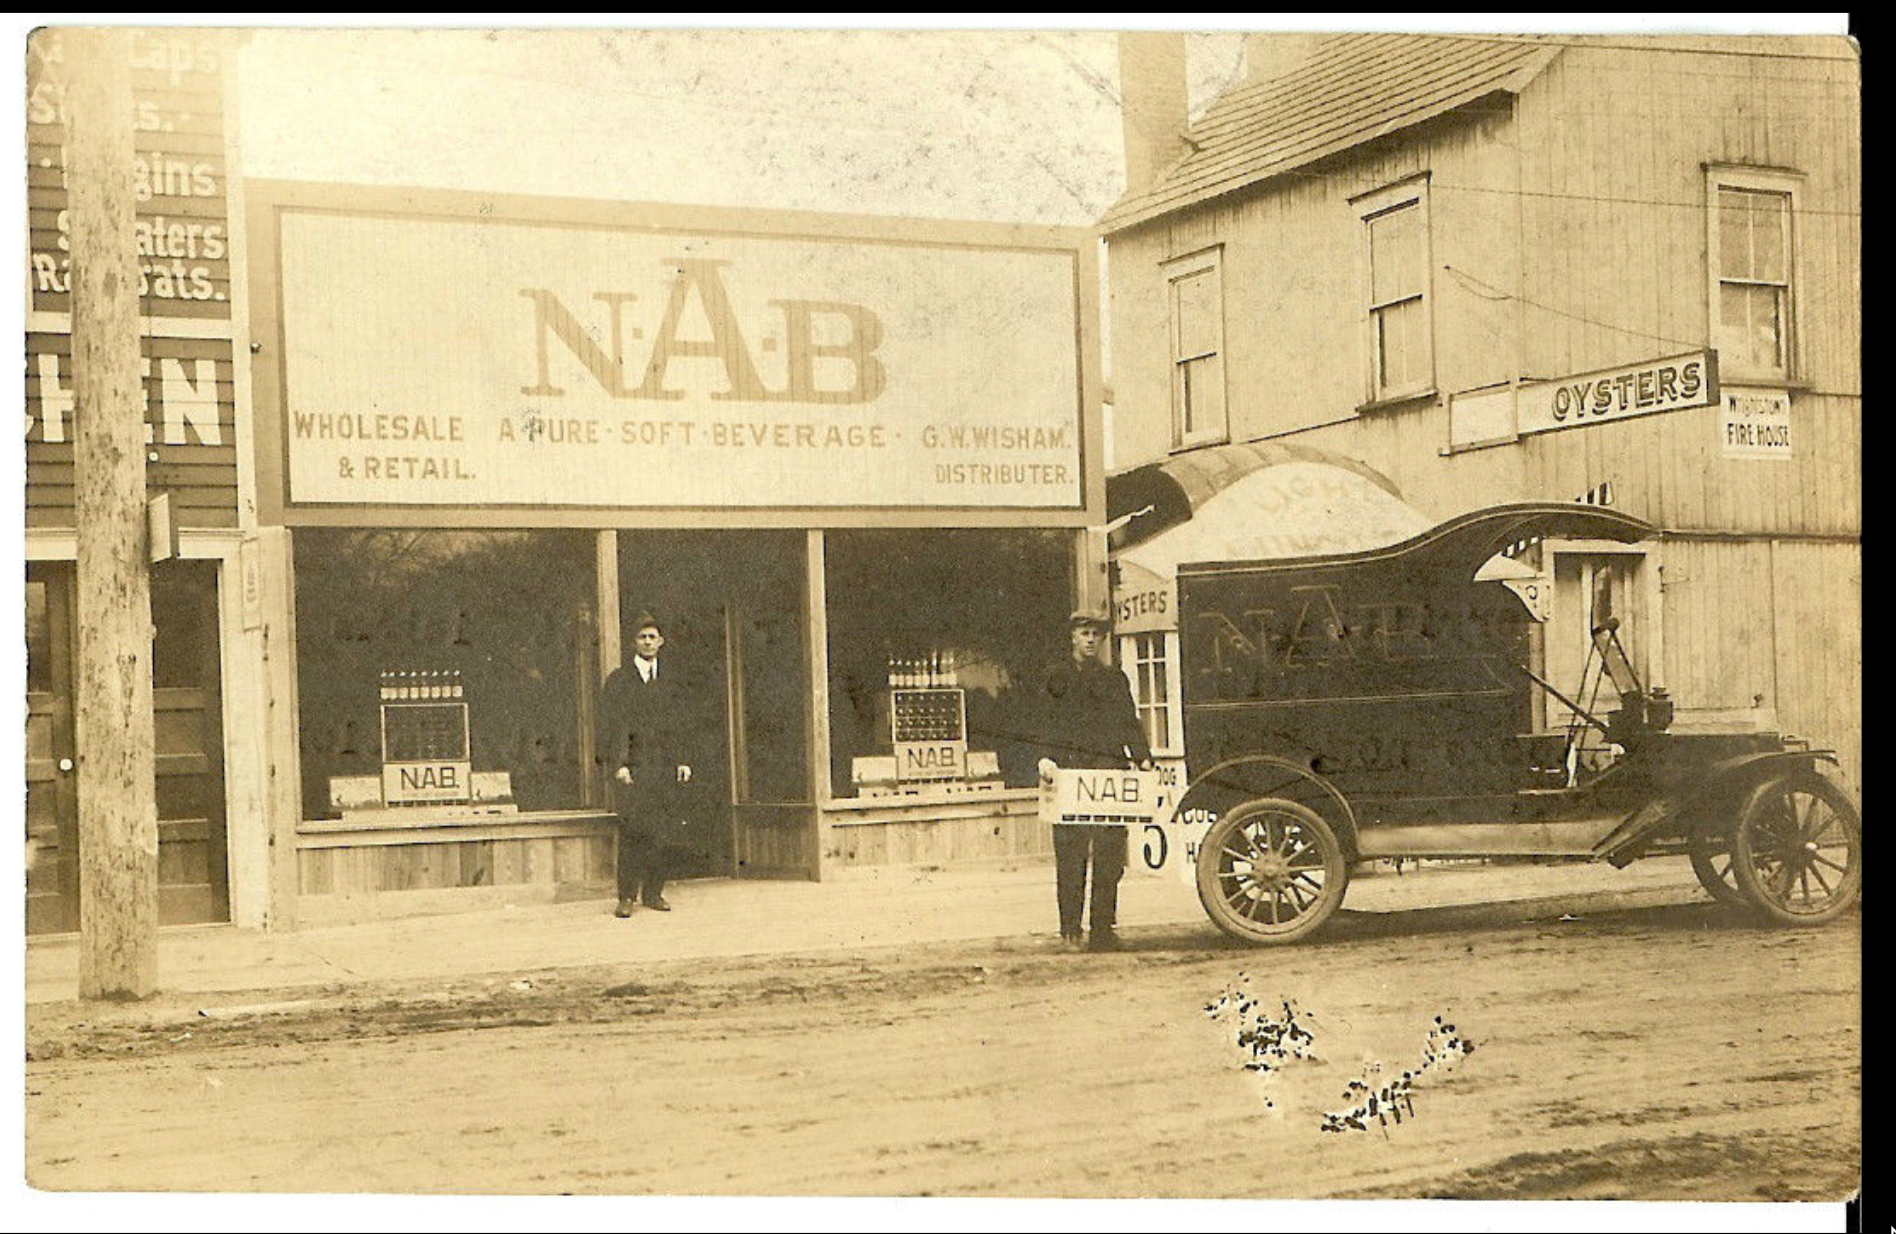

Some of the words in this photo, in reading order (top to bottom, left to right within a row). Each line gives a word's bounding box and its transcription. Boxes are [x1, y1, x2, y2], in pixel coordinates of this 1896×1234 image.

[1552, 362, 1702, 421] OYSTERS
[294, 411, 464, 442] WHOLESALE
[526, 417, 600, 440] PURE
[621, 421, 696, 445] SOFT
[712, 422, 888, 449] BEVERAGE
[338, 457, 355, 479] &
[364, 457, 477, 480] RETAIL.
[1112, 590, 1168, 624] YSTERS
